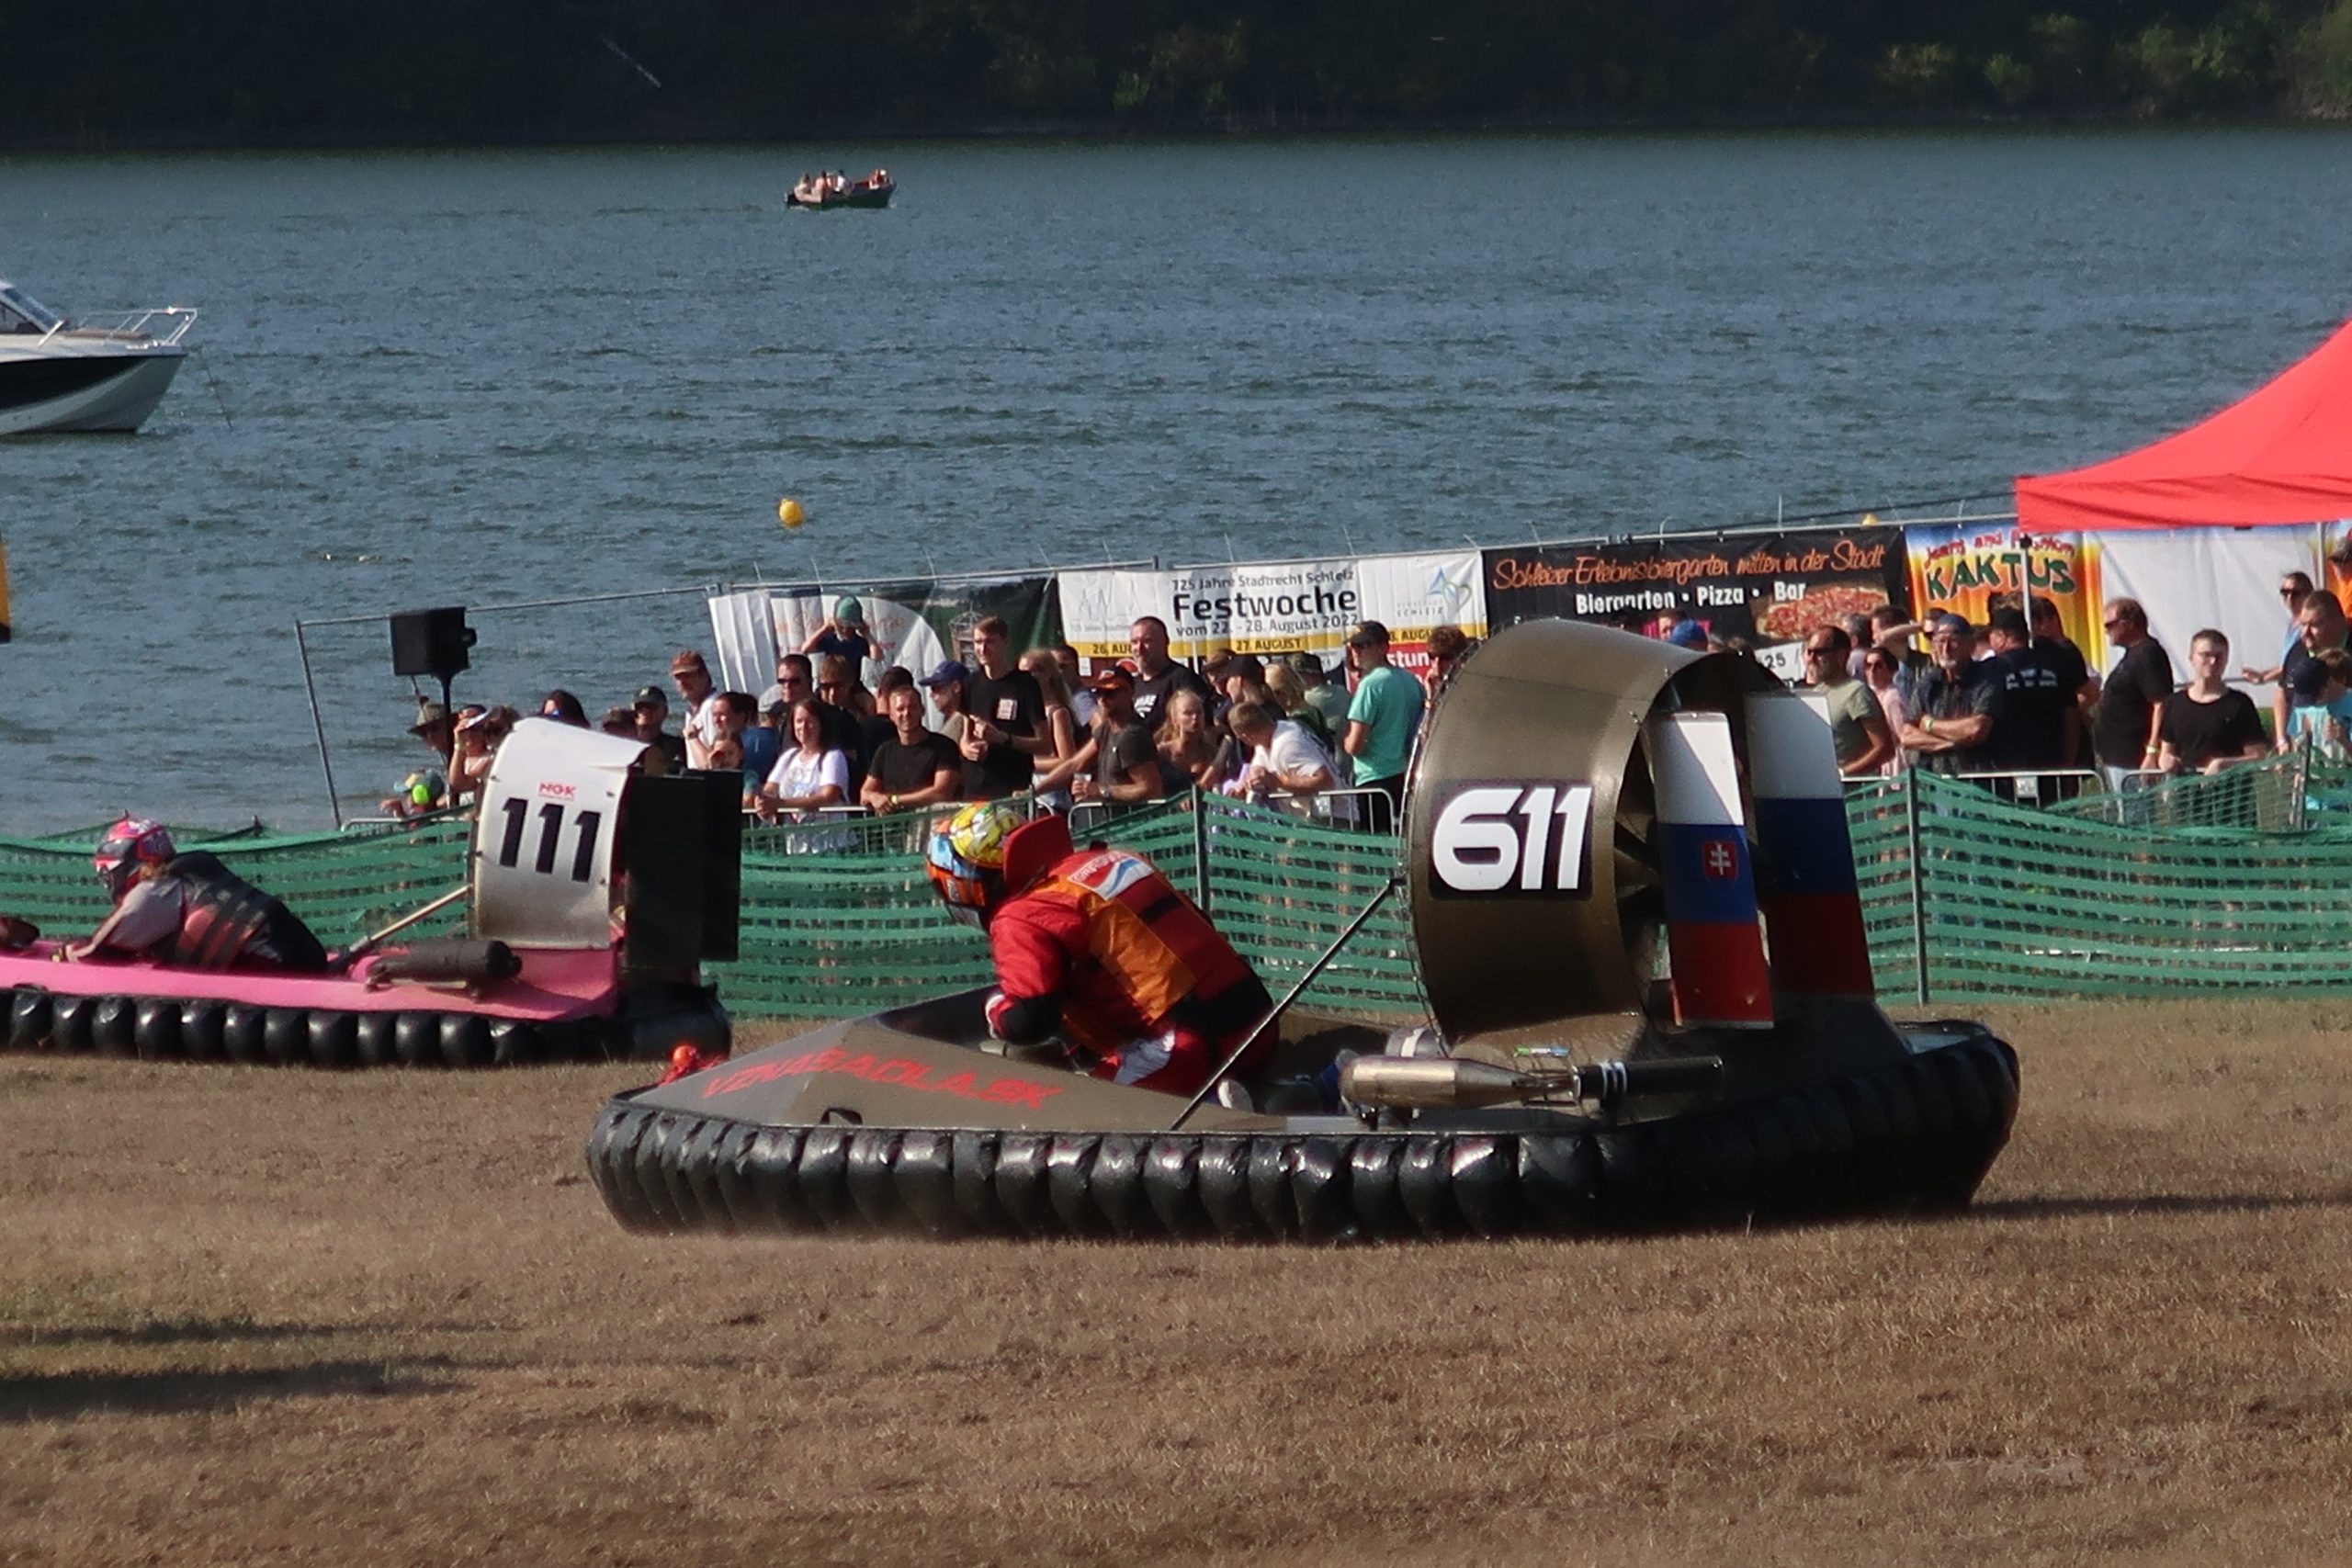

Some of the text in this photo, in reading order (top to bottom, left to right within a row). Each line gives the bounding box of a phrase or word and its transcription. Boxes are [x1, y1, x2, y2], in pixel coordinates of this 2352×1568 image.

[1974, 531, 2003, 548] and
[1199, 577, 1235, 591] Jahre
[1238, 573, 1303, 588] Stadtrecht
[1306, 568, 1354, 584] Schleiz
[1493, 540, 1885, 590] Schleizer Erlebnisbiergarten mitten in der Stadt
[1927, 553, 2076, 600] KAKTUS
[1173, 586, 1357, 621] Festwoche
[1575, 581, 1806, 615] Biergarten Pizza Bar
[1176, 626, 1207, 637] vom
[1246, 619, 1267, 633] 28.
[1270, 616, 1317, 634] August
[1322, 615, 1358, 629] 2022
[1255, 638, 1301, 650] AUGUST
[499, 797, 601, 883] 111
[1433, 787, 1592, 891] 611
